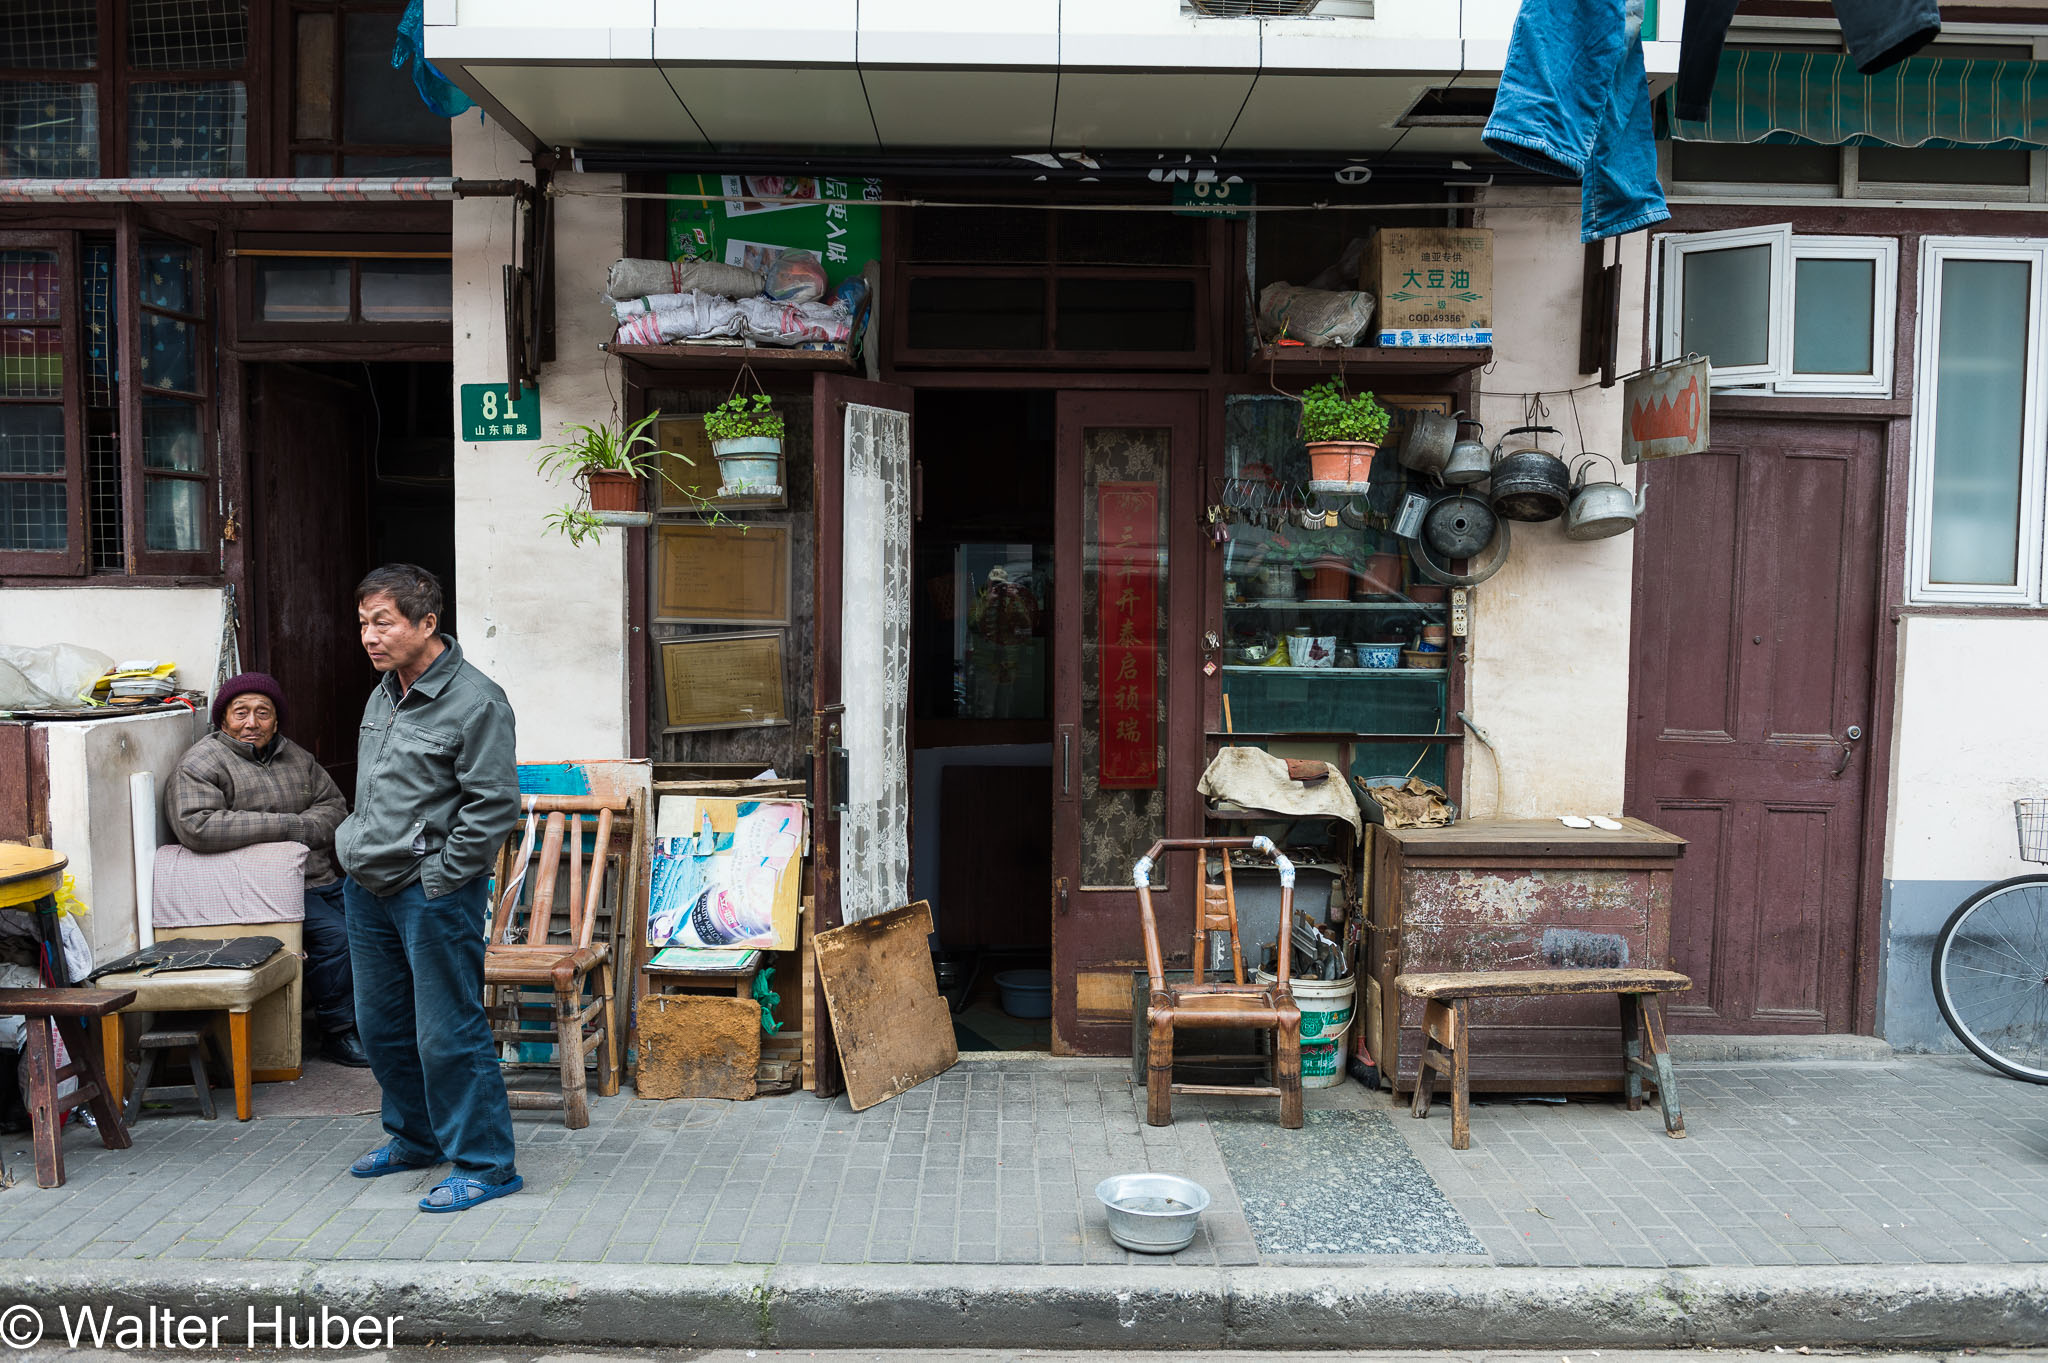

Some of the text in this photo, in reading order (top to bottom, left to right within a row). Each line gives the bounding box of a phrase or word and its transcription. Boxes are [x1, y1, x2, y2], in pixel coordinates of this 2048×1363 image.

[1421, 252, 1463, 263] 迪亚专供
[1402, 269, 1470, 289] 大豆油
[1423, 300, 1447, 310] 一级
[482, 390, 519, 420] 81
[475, 423, 528, 436] 山东南路
[1114, 525, 1144, 744] 三羊开泰启祯瑞
